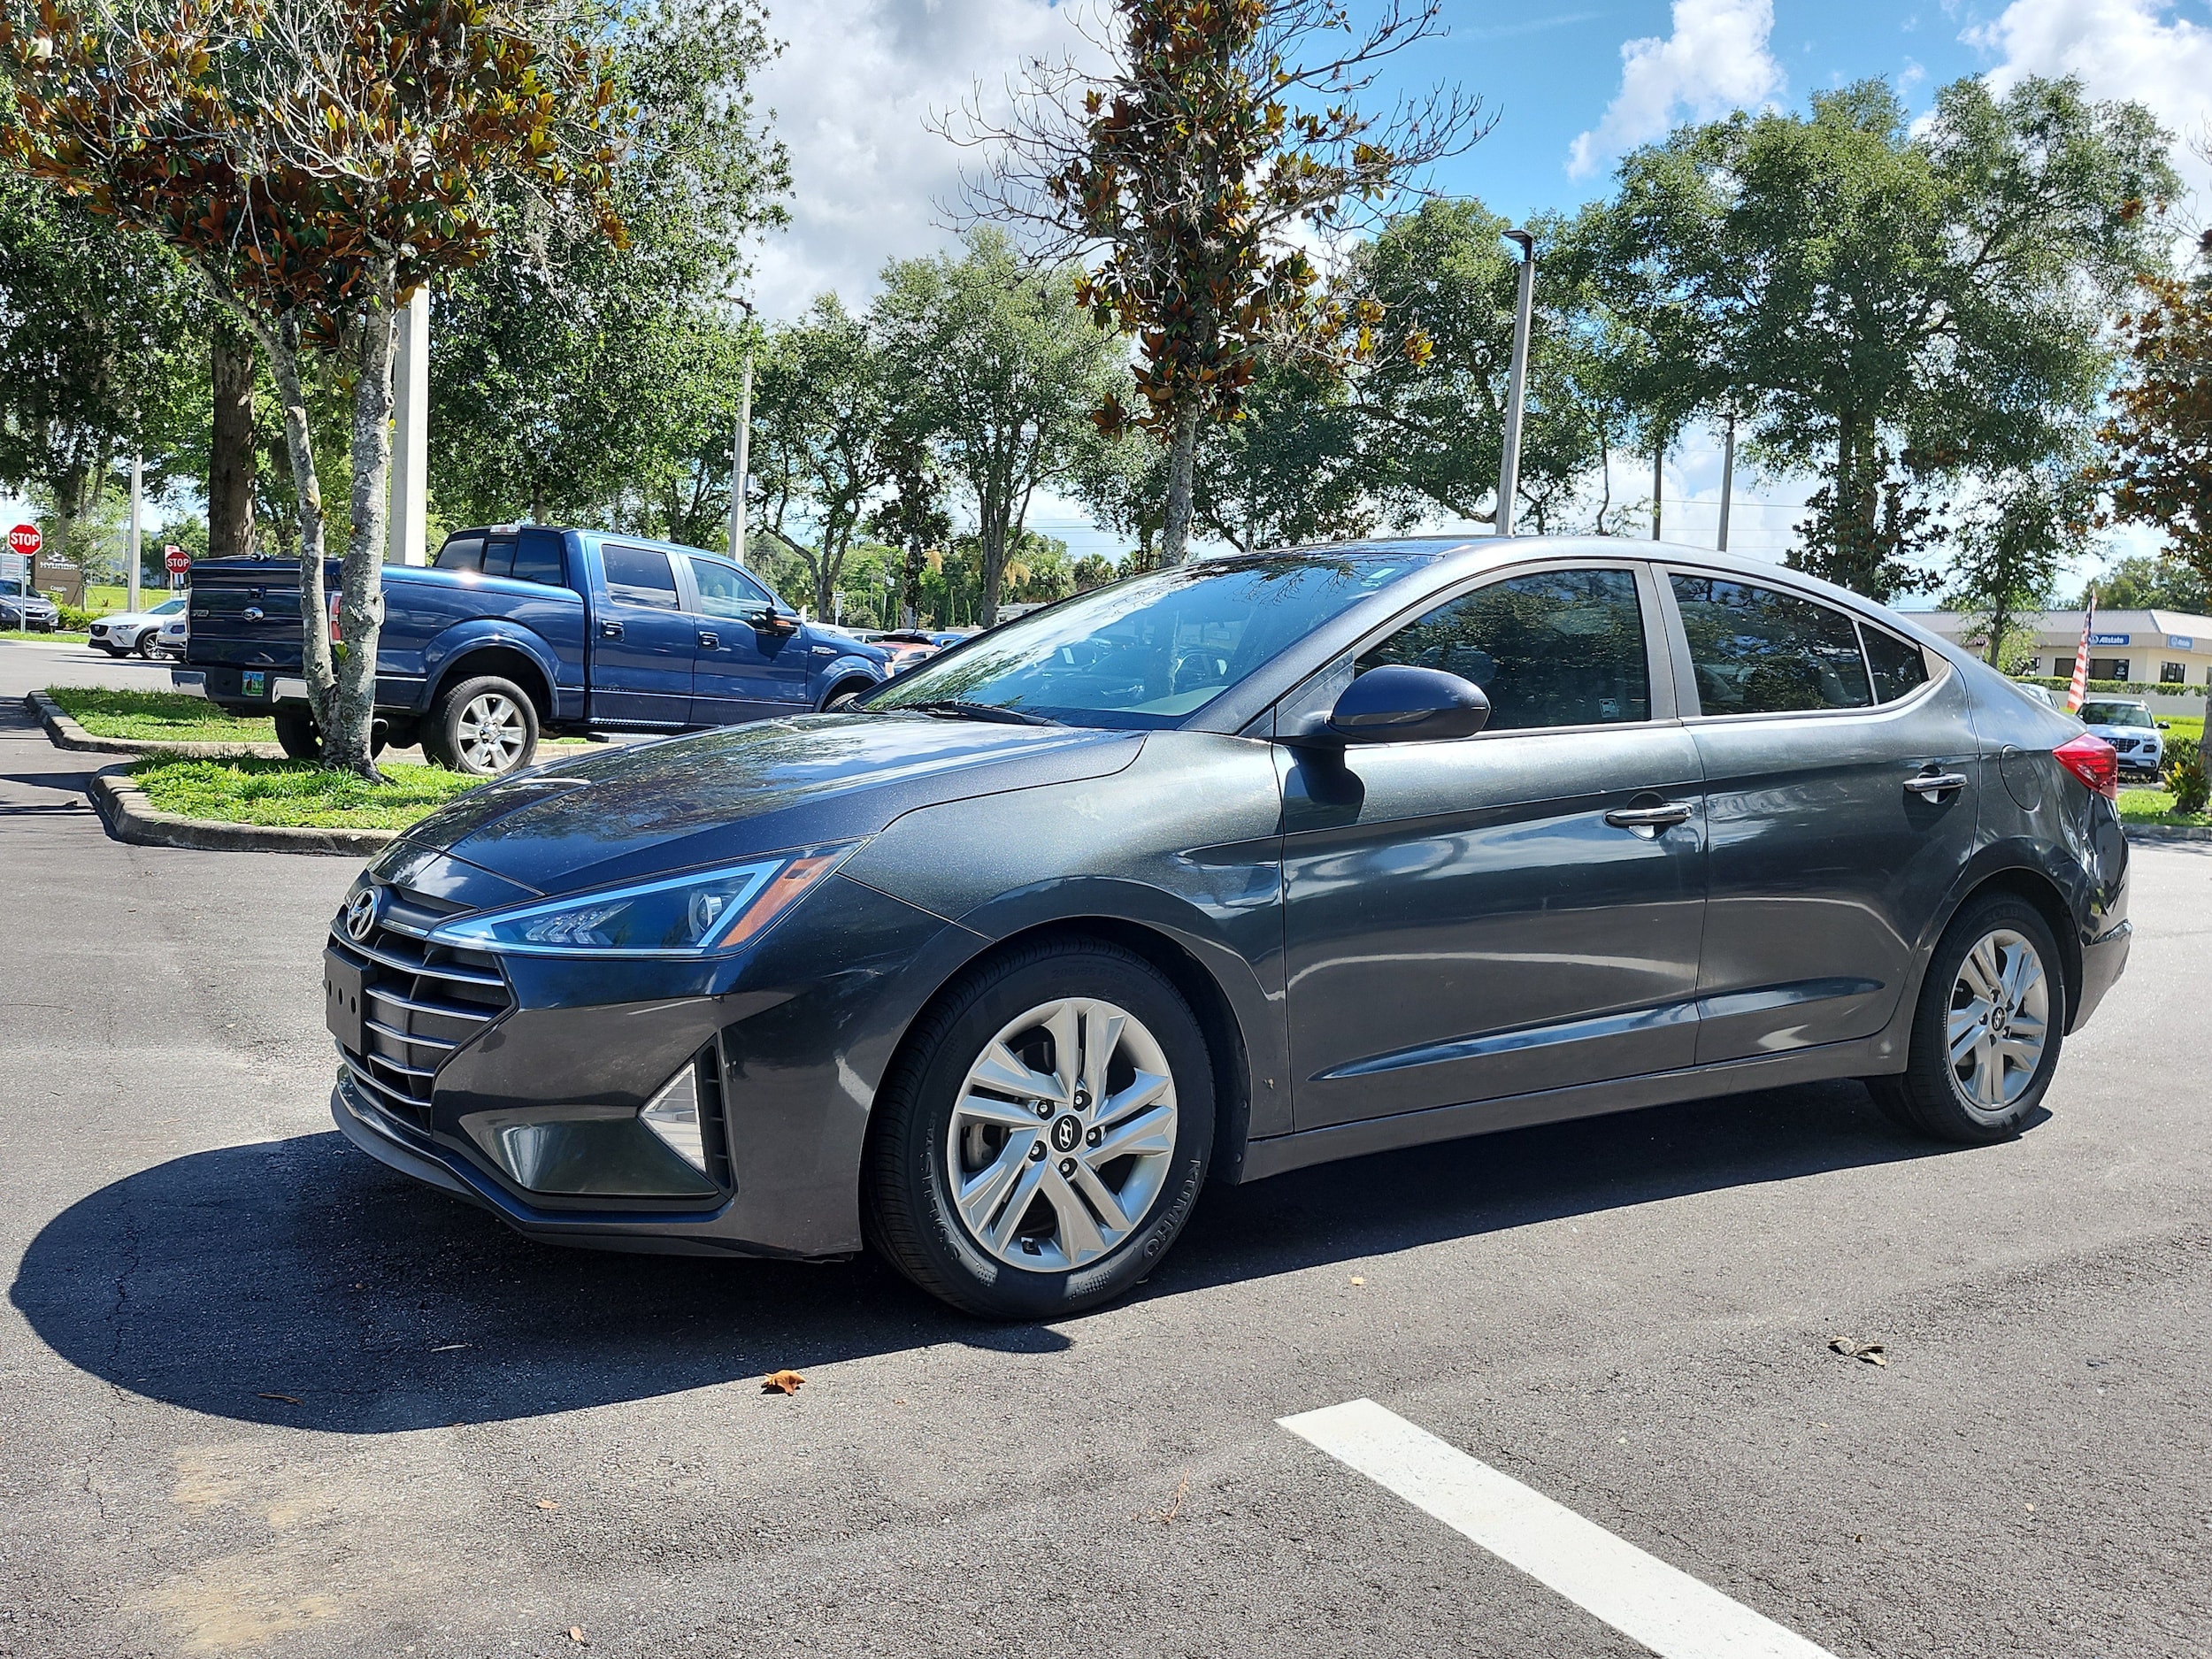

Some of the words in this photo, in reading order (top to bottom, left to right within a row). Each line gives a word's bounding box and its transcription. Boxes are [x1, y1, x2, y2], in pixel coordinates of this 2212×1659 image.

[11, 532, 40, 547] STOP
[167, 557, 189, 567] STOP
[1142, 1159, 1202, 1256] KUMHO
